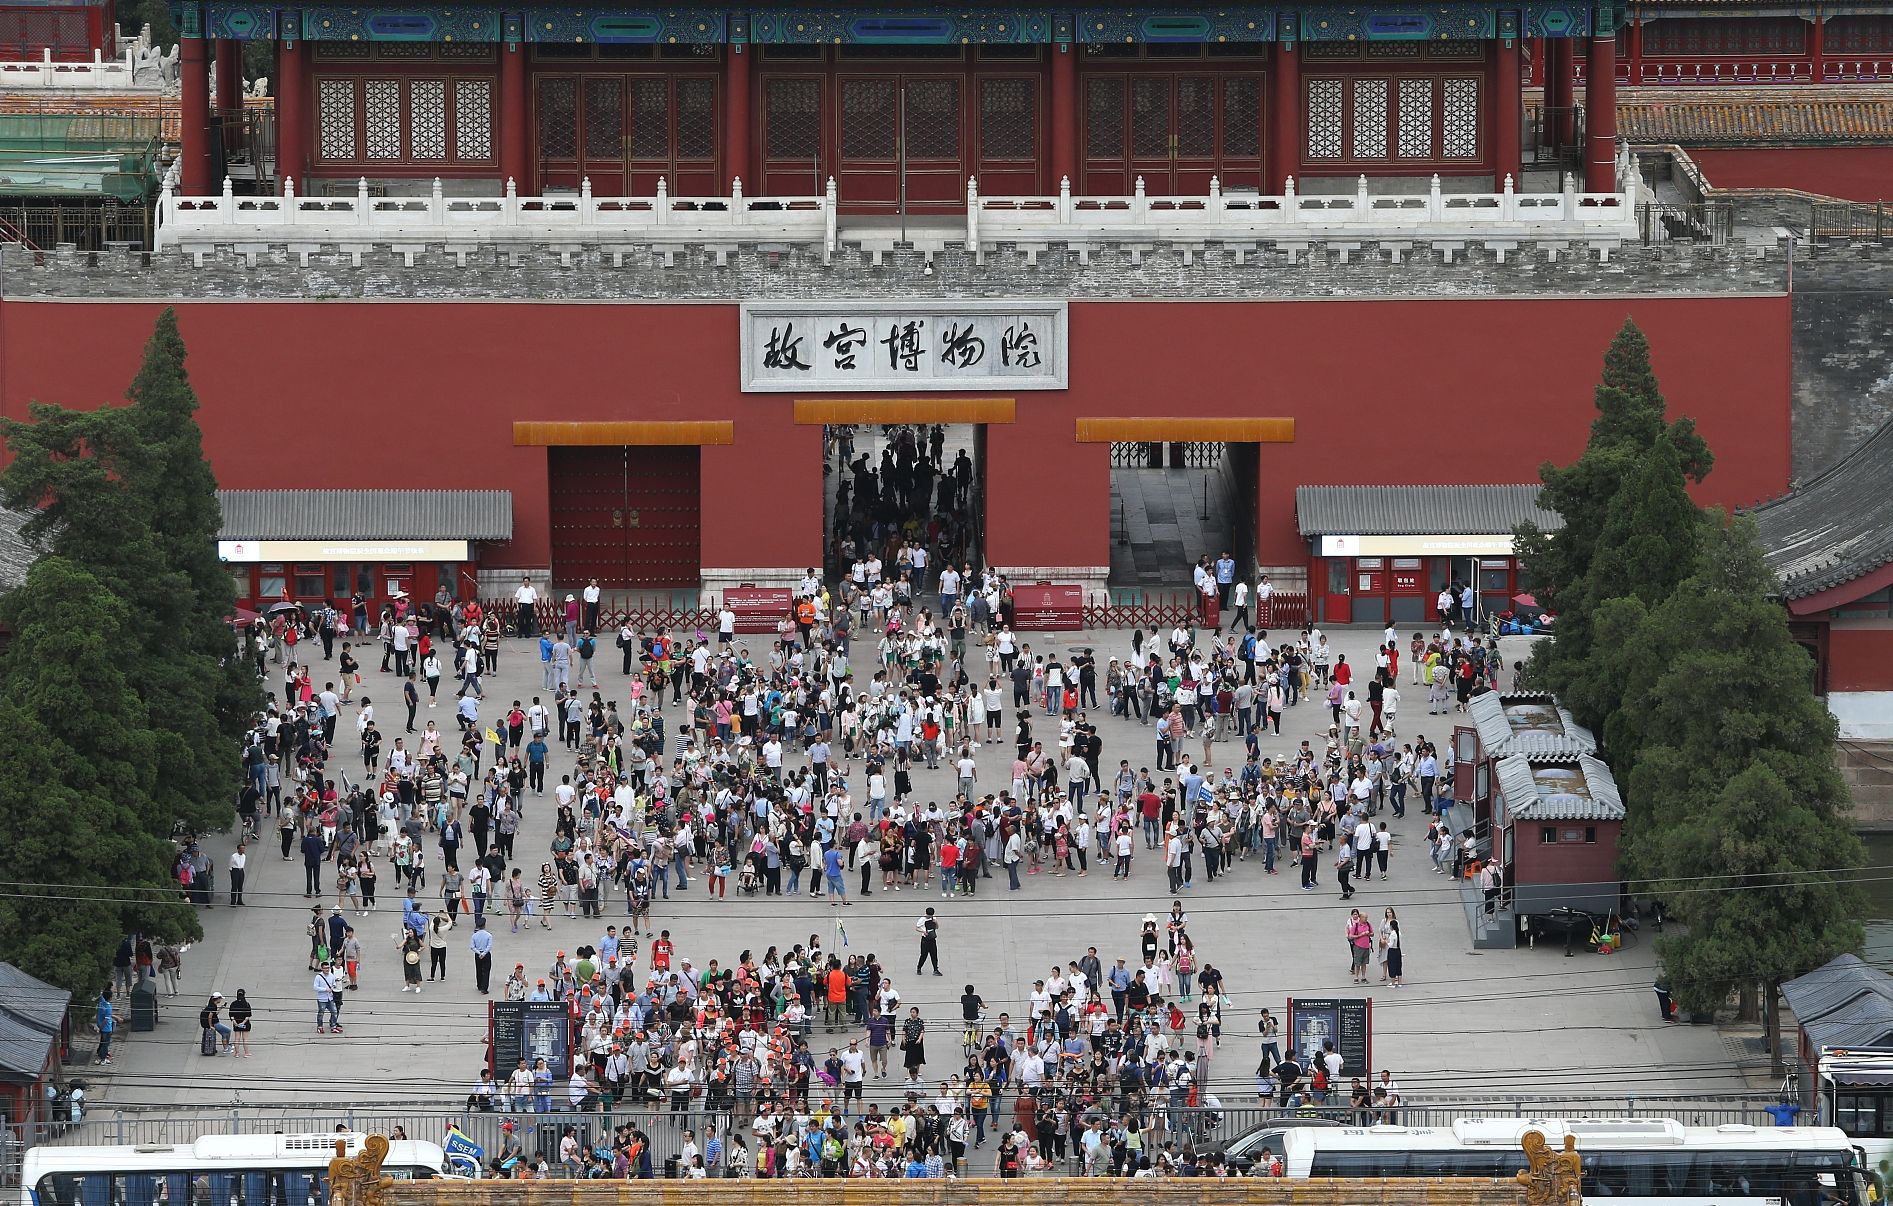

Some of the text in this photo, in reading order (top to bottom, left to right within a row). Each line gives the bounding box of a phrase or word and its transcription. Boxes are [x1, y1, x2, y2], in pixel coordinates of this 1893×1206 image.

[763, 321, 1041, 371] 故宫博物院
[452, 1140, 477, 1155] SSEM
